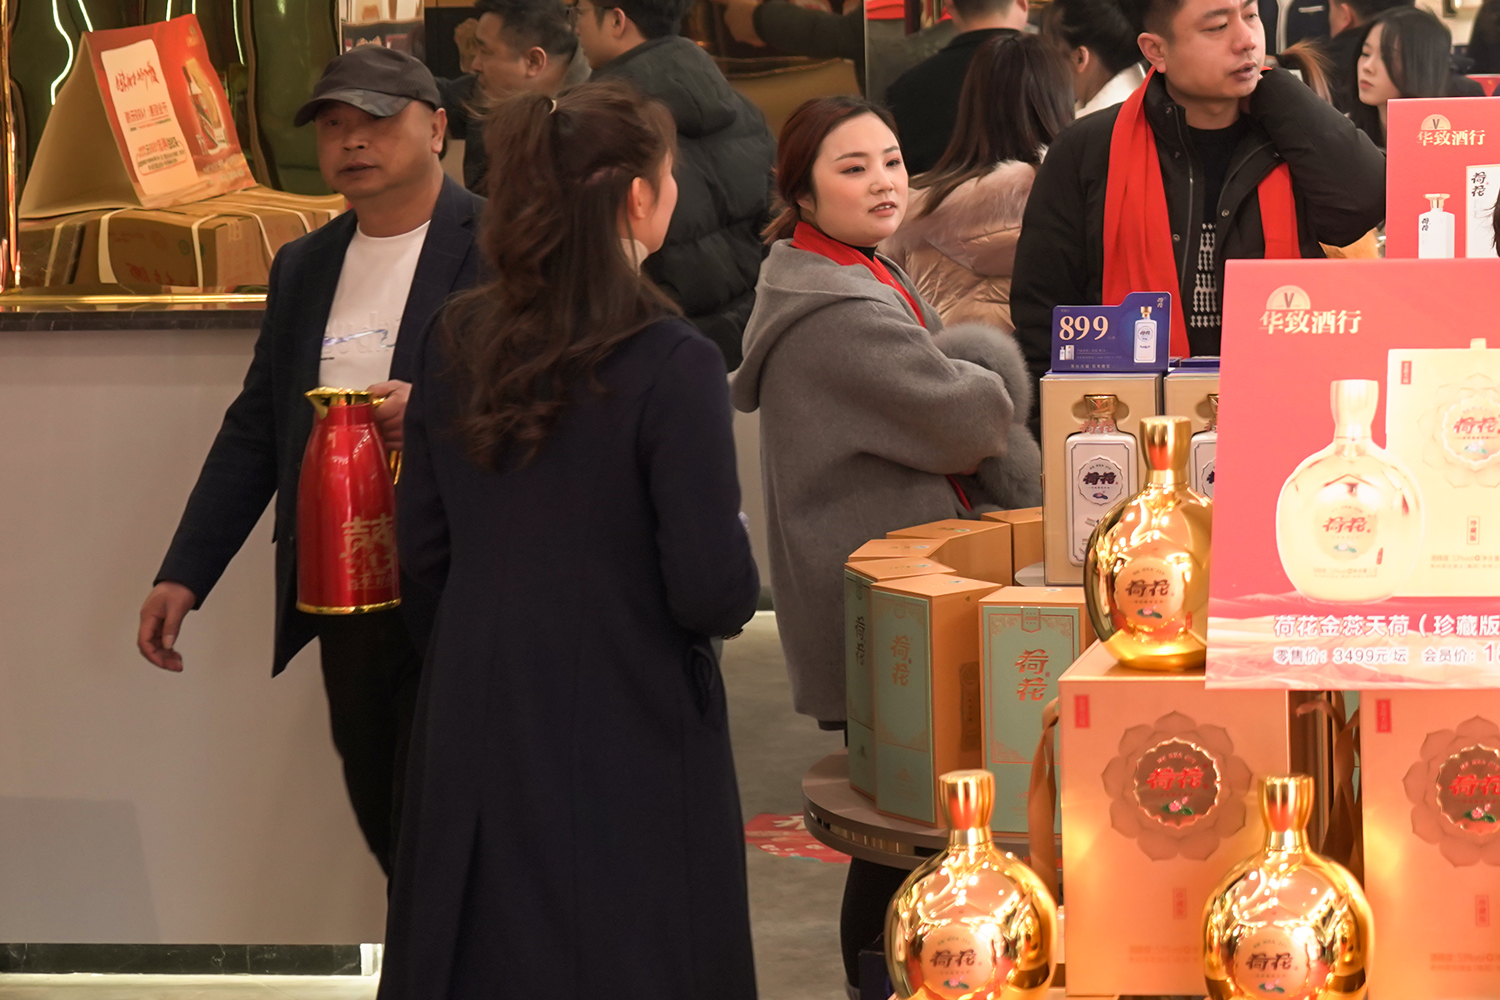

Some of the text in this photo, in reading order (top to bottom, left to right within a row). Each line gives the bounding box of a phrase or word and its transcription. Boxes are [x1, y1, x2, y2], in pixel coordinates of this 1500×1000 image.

[1432, 119, 1440, 130] V
[1416, 129, 1486, 147] 华致酒行
[1284, 292, 1295, 308] V
[1059, 315, 1109, 341] 899
[1259, 309, 1362, 335] 华致酒行
[1083, 471, 1117, 485] 荷花
[1125, 579, 1171, 598] 荷花
[891, 635, 911, 687] 荷花
[1014, 648, 1050, 702] 荷花
[1147, 766, 1204, 790] 荷花
[930, 948, 977, 968] 荷花
[1246, 952, 1294, 971] 荷花
